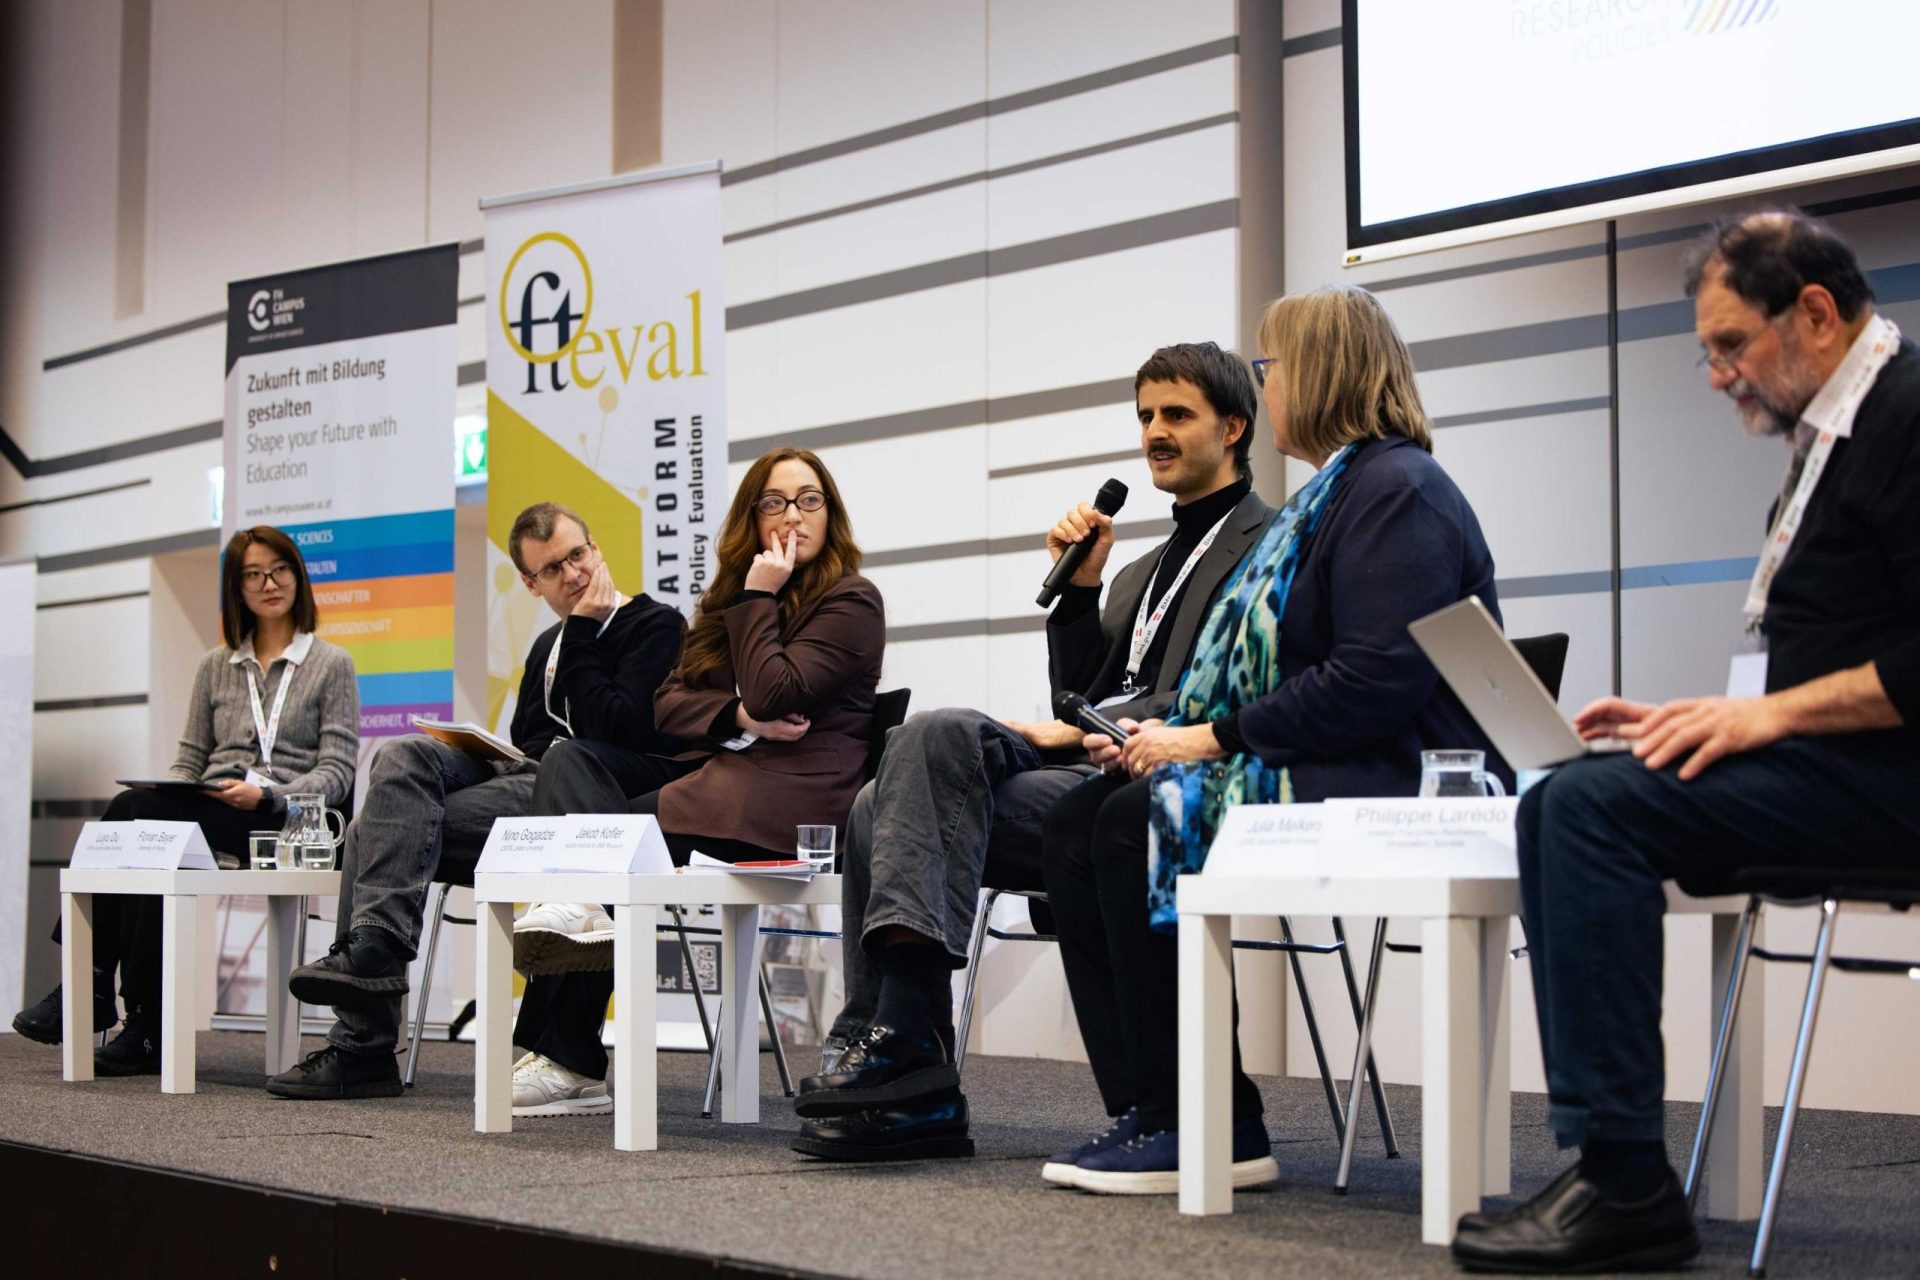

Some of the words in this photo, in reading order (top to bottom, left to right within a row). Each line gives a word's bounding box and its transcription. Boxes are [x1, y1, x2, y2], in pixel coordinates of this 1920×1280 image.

[1511, 0, 1670, 40] RESEAR
[272, 297, 305, 313] CAMPUS
[272, 313, 294, 326] WIEN
[247, 367, 300, 393] Zukunft
[306, 366, 328, 384] mit
[332, 358, 386, 380] Bildung
[247, 399, 312, 428] gestalten
[247, 431, 285, 456] Shape
[287, 430, 318, 451] your
[322, 423, 365, 444] Future
[369, 415, 398, 438] with
[246, 460, 308, 484] Education
[687, 415, 704, 523] Evaluation
[655, 418, 680, 596] ATFORM
[297, 529, 333, 546] SCIENCES
[690, 533, 708, 595] Policy
[1354, 806, 1432, 826] Philippe
[501, 829, 518, 841] Nino
[520, 828, 556, 843] Gogadze
[575, 827, 599, 839] Jakob
